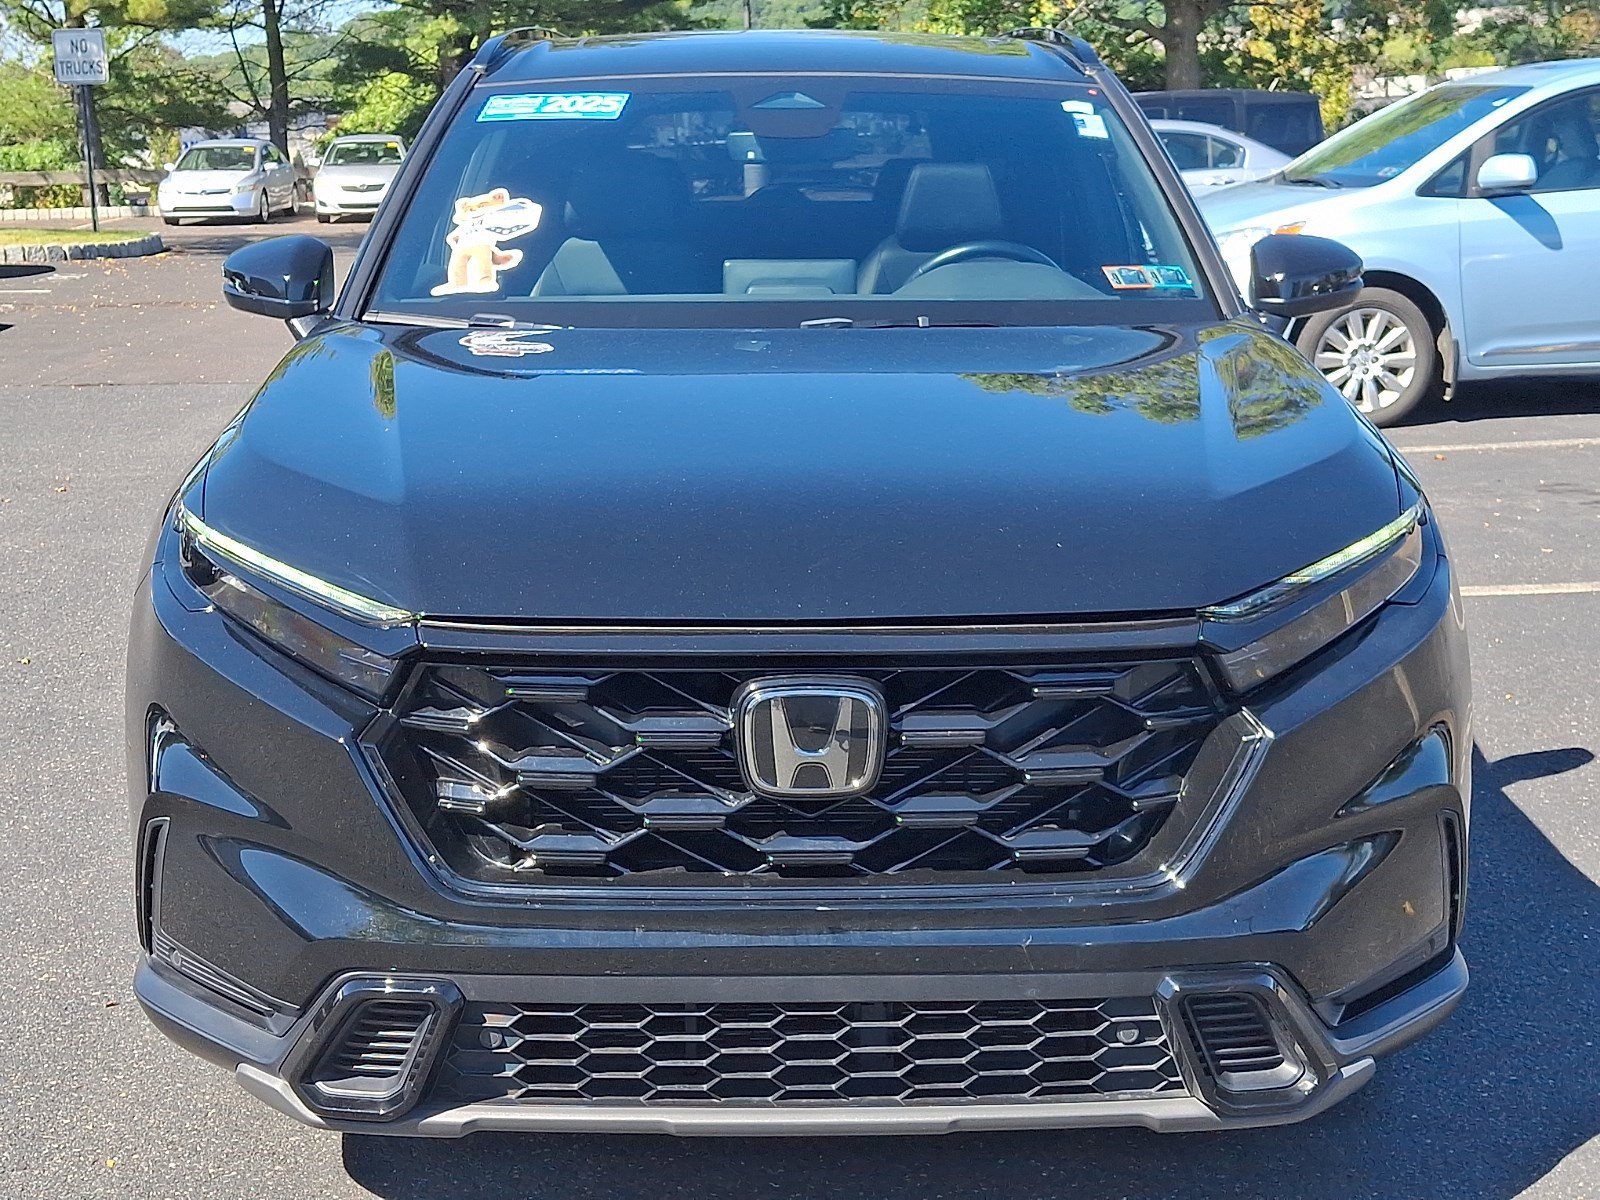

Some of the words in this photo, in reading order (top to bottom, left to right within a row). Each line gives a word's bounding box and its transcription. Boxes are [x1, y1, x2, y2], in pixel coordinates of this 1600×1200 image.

[70, 38, 88, 54] NO
[59, 60, 104, 76] TRUCKS
[541, 95, 622, 113] 2025
